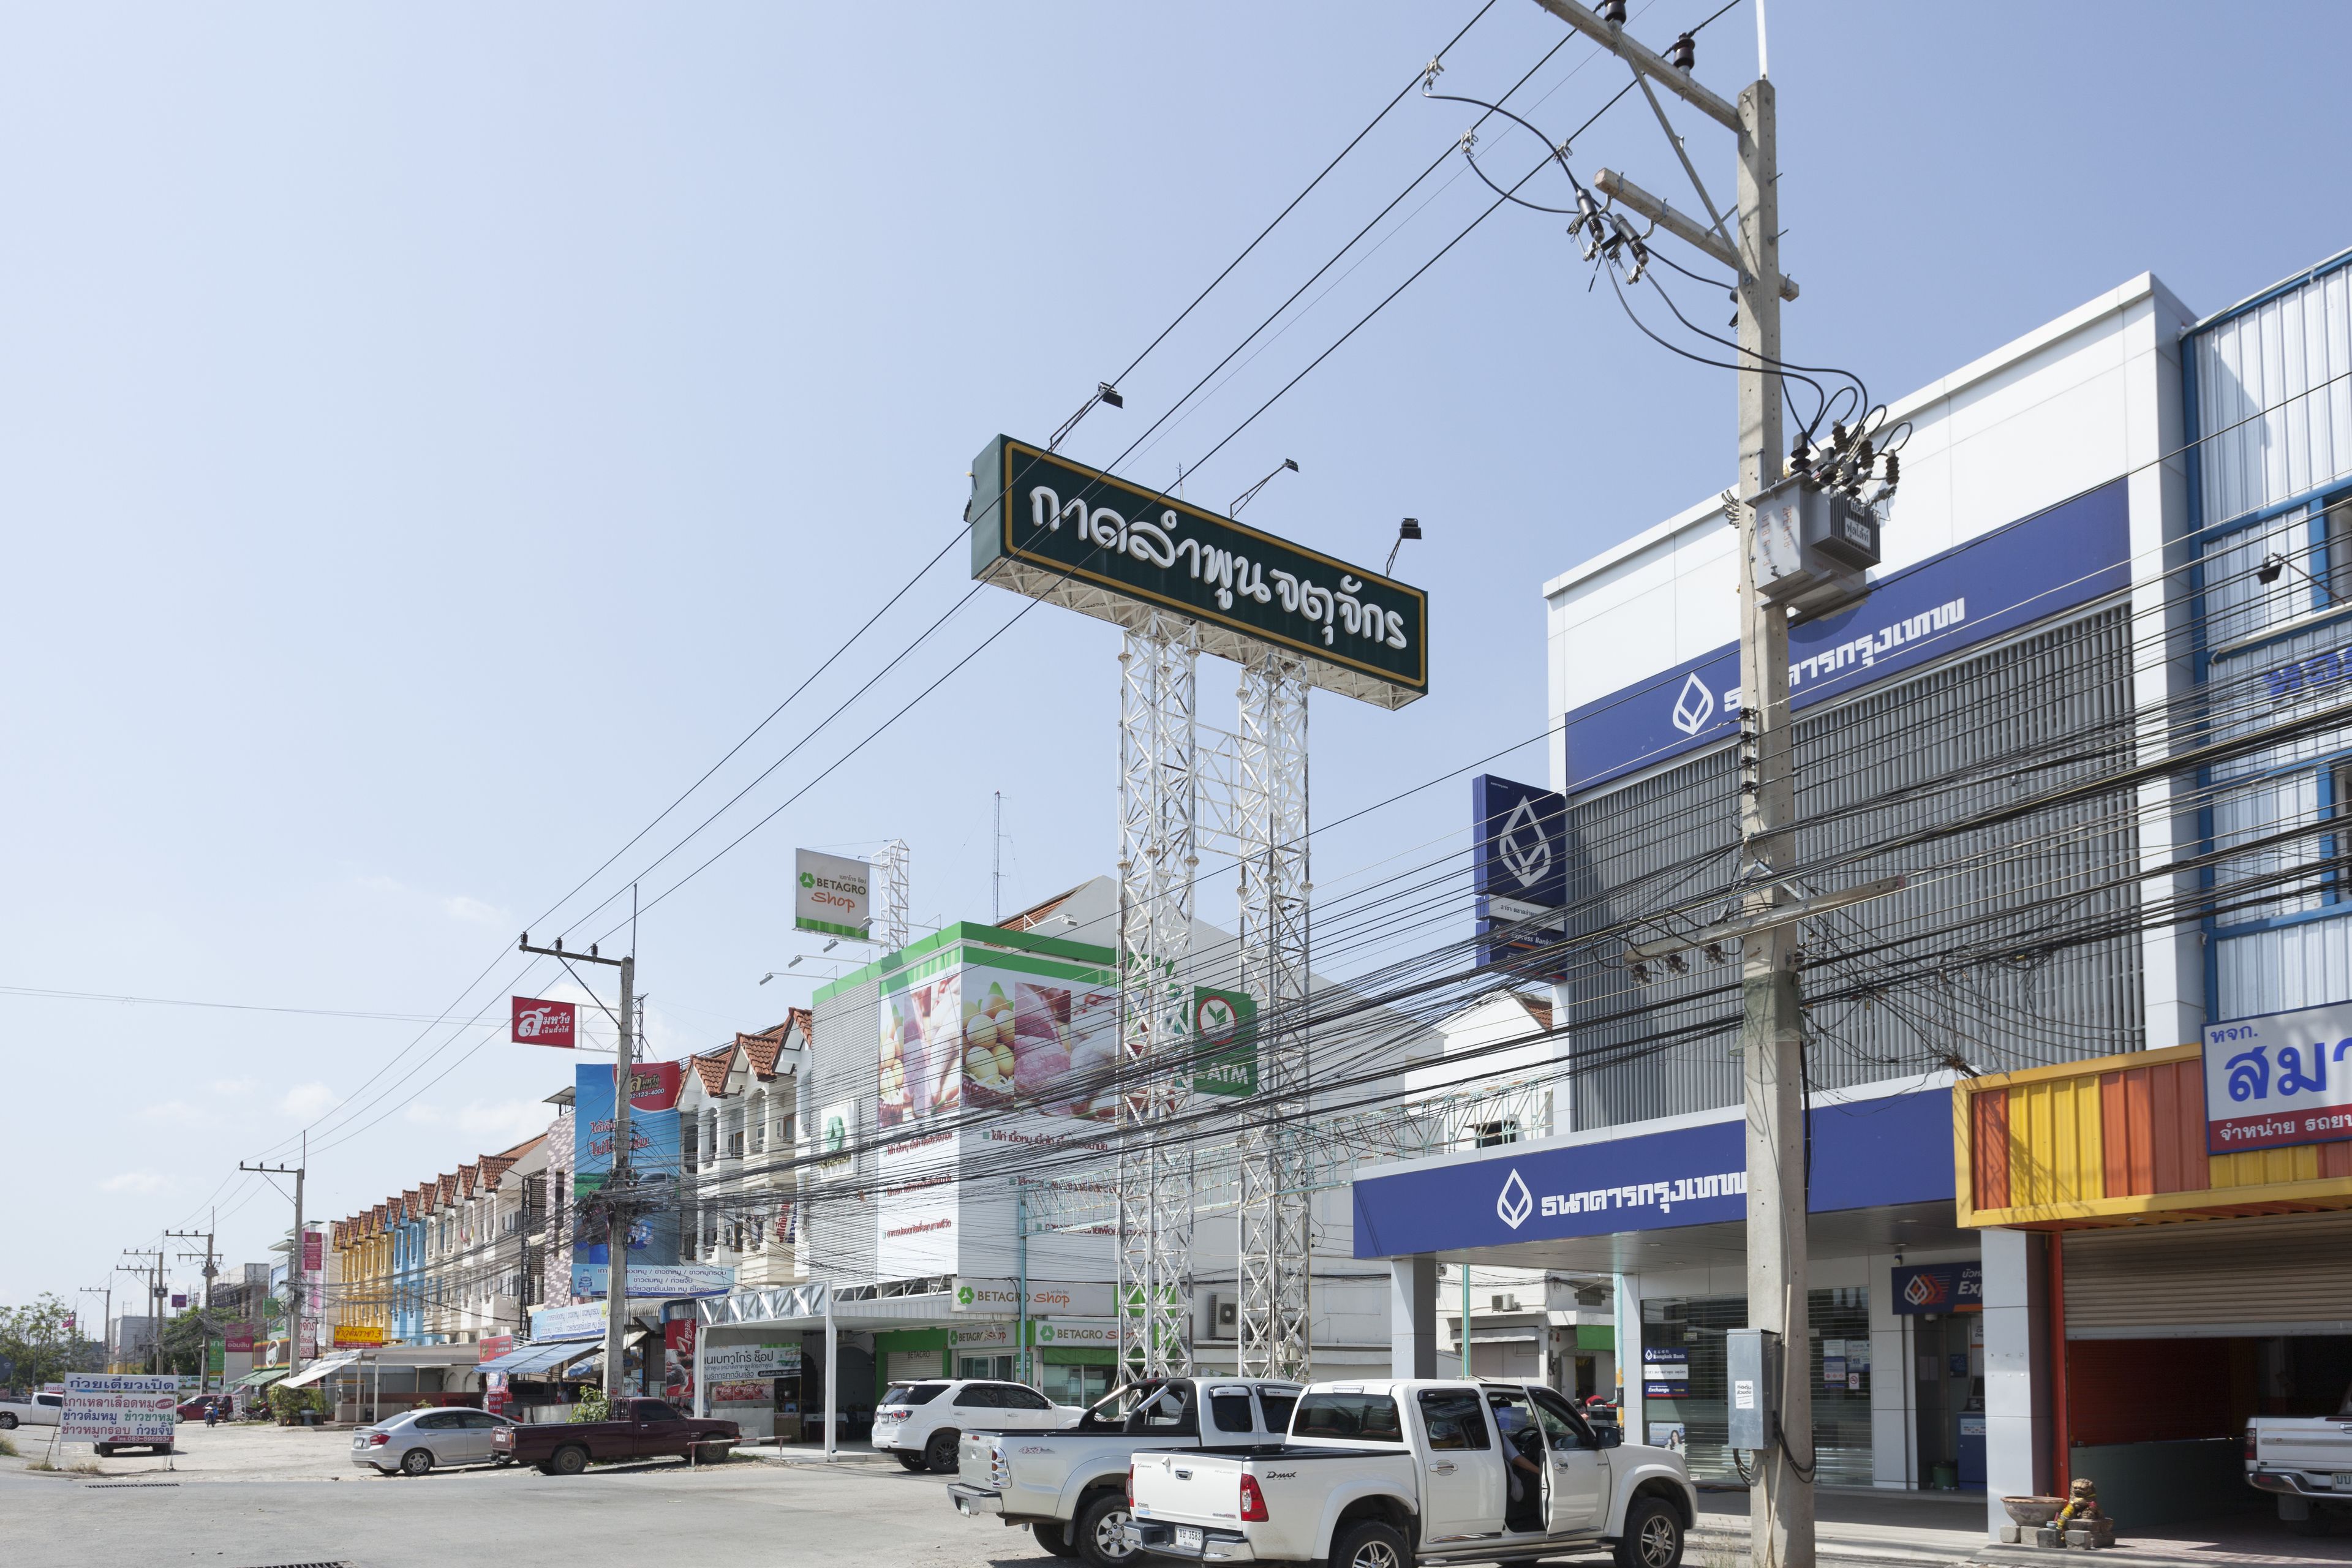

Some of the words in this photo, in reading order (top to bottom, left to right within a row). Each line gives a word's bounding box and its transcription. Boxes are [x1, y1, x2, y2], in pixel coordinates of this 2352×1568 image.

[1852, 502, 1864, 514] 100
[1724, 597, 1965, 712] ธคารกรุงเทพ
[816, 877, 867, 895] BETAGRO
[811, 892, 856, 913] Shop
[2210, 1025, 2259, 1044] หจก.
[2219, 1118, 2296, 1140] จำหน่าย
[1541, 1170, 1747, 1216] ธนาคารกรุงเทพ
[1034, 1292, 1070, 1308] Shop
[1057, 1329, 1103, 1340] BETAGRO
[704, 1351, 752, 1365] านเบทาโกร
[70, 1376, 174, 1390] ก๋วยเตี๋ยวเป็ด
[64, 1395, 155, 1412] เกาเหลาเลือดหมู
[63, 1408, 117, 1425] ข้าวต้มหมู
[124, 1409, 174, 1425] ข้าวขาหมู
[62, 1422, 130, 1438] ข้าวหมูกรอบ
[137, 1422, 173, 1436] ก๋วยจั๊บ
[1266, 1471, 1297, 1479] D-MAX
[1188, 1530, 1201, 1541] 3583
